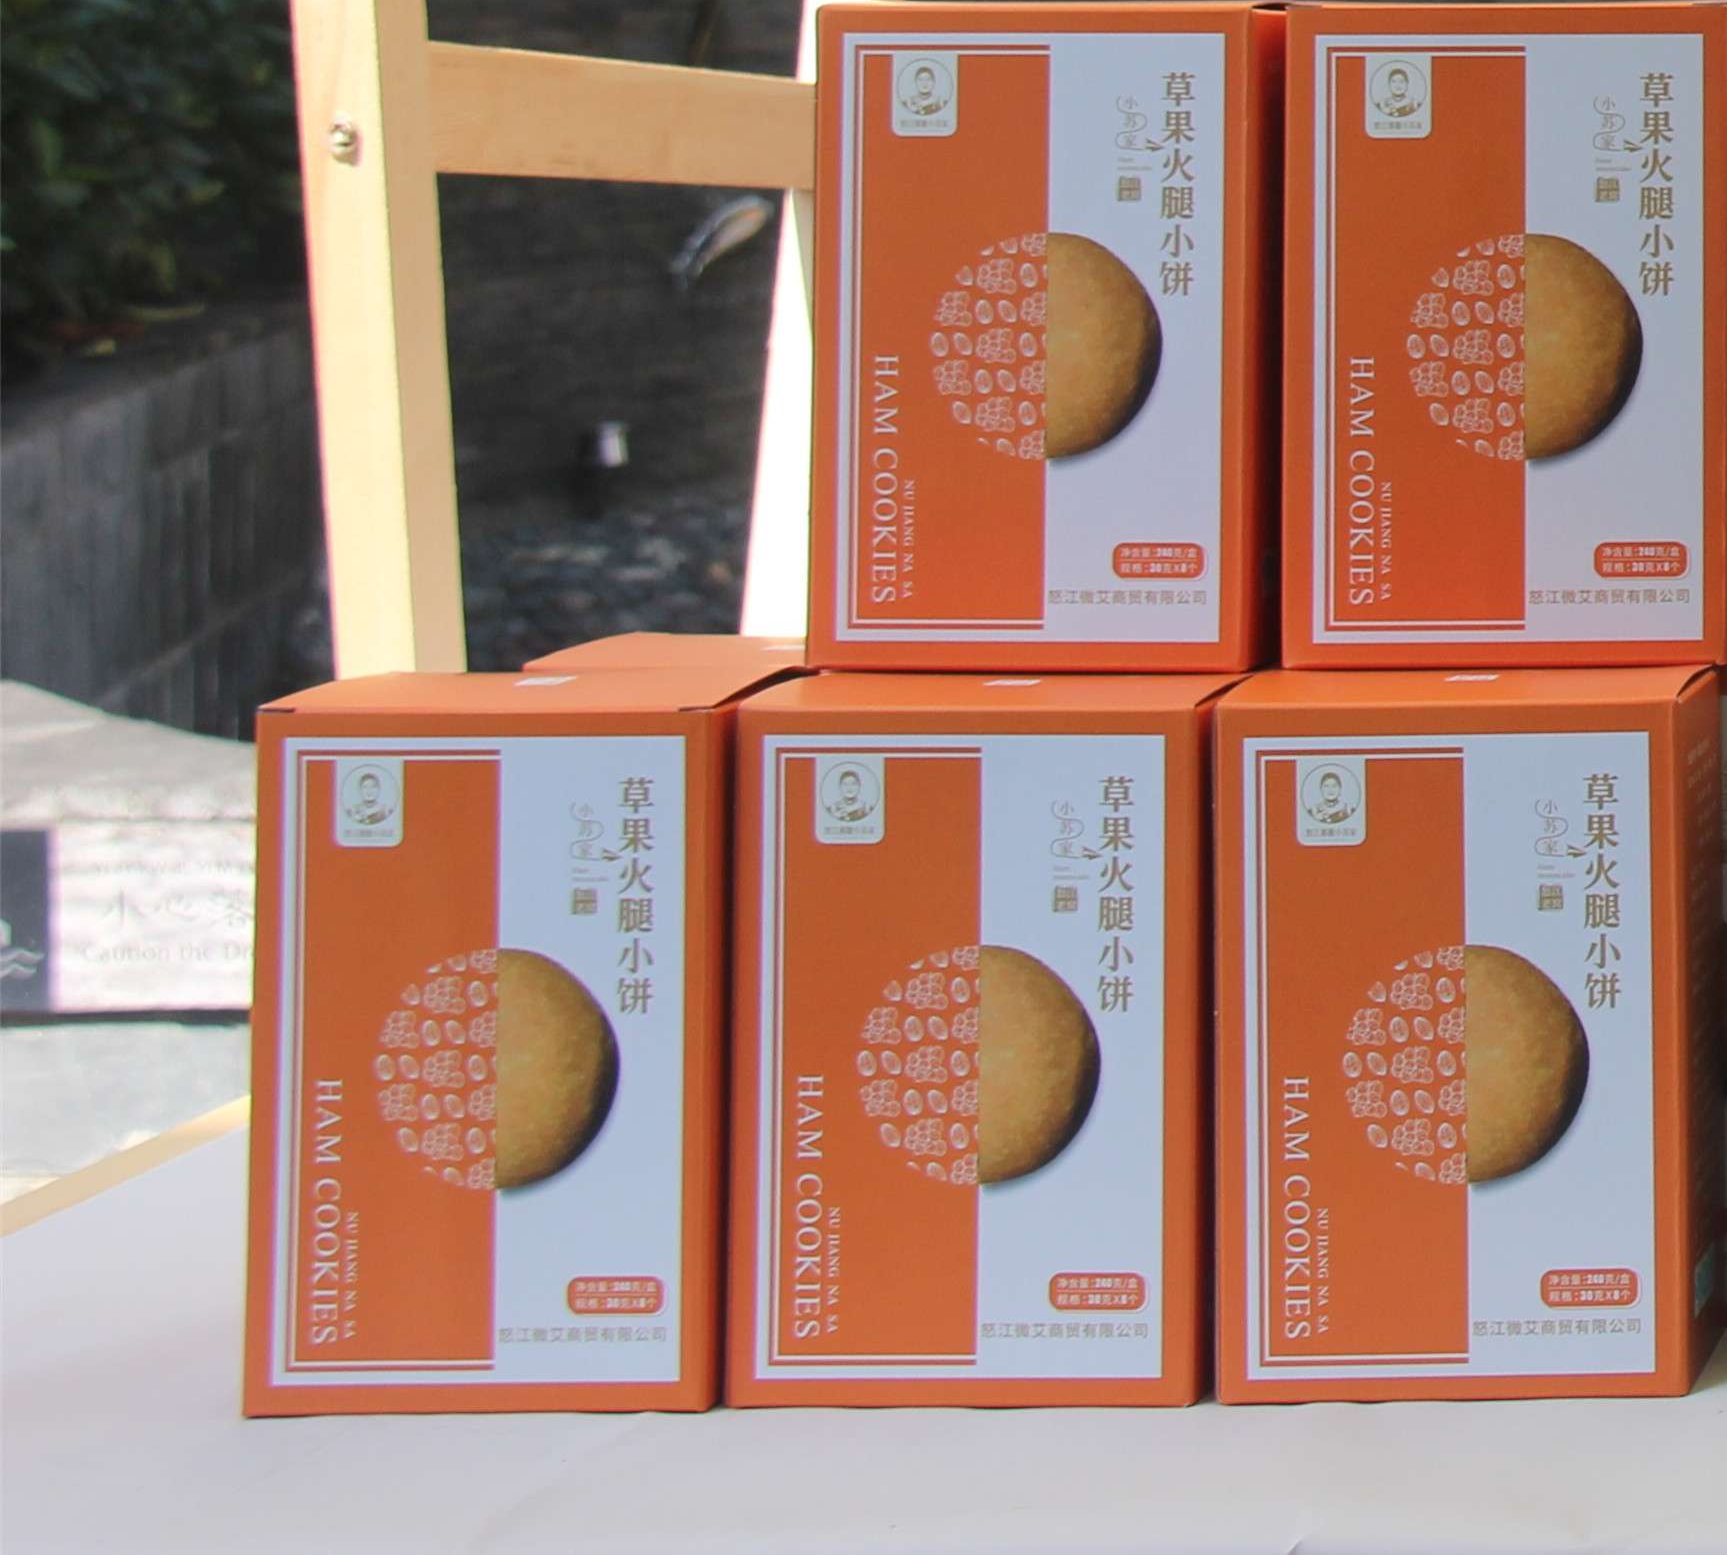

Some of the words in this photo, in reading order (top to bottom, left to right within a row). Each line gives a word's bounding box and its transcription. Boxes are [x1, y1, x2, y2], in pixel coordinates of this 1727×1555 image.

[1159, 71, 1196, 297] 草果火腿小饼
[1639, 72, 1674, 297] 草果火腿小饼
[873, 355, 899, 434] HAM
[1349, 357, 1375, 436] HAM
[871, 447, 899, 604] COOKIES
[1349, 449, 1375, 605] COOKIES
[616, 777, 655, 1015] 草果火腿小饼
[1097, 776, 1135, 1013] 草果火腿小饼
[1583, 773, 1622, 1009] 草果火腿小饼
[315, 1079, 342, 1163] HAM
[796, 1074, 824, 1159] HAM
[1283, 1077, 1310, 1160] HAM
[312, 1177, 342, 1343] COOKIES
[794, 1172, 823, 1339] COOKIES
[1284, 1174, 1311, 1339] COOKIES
